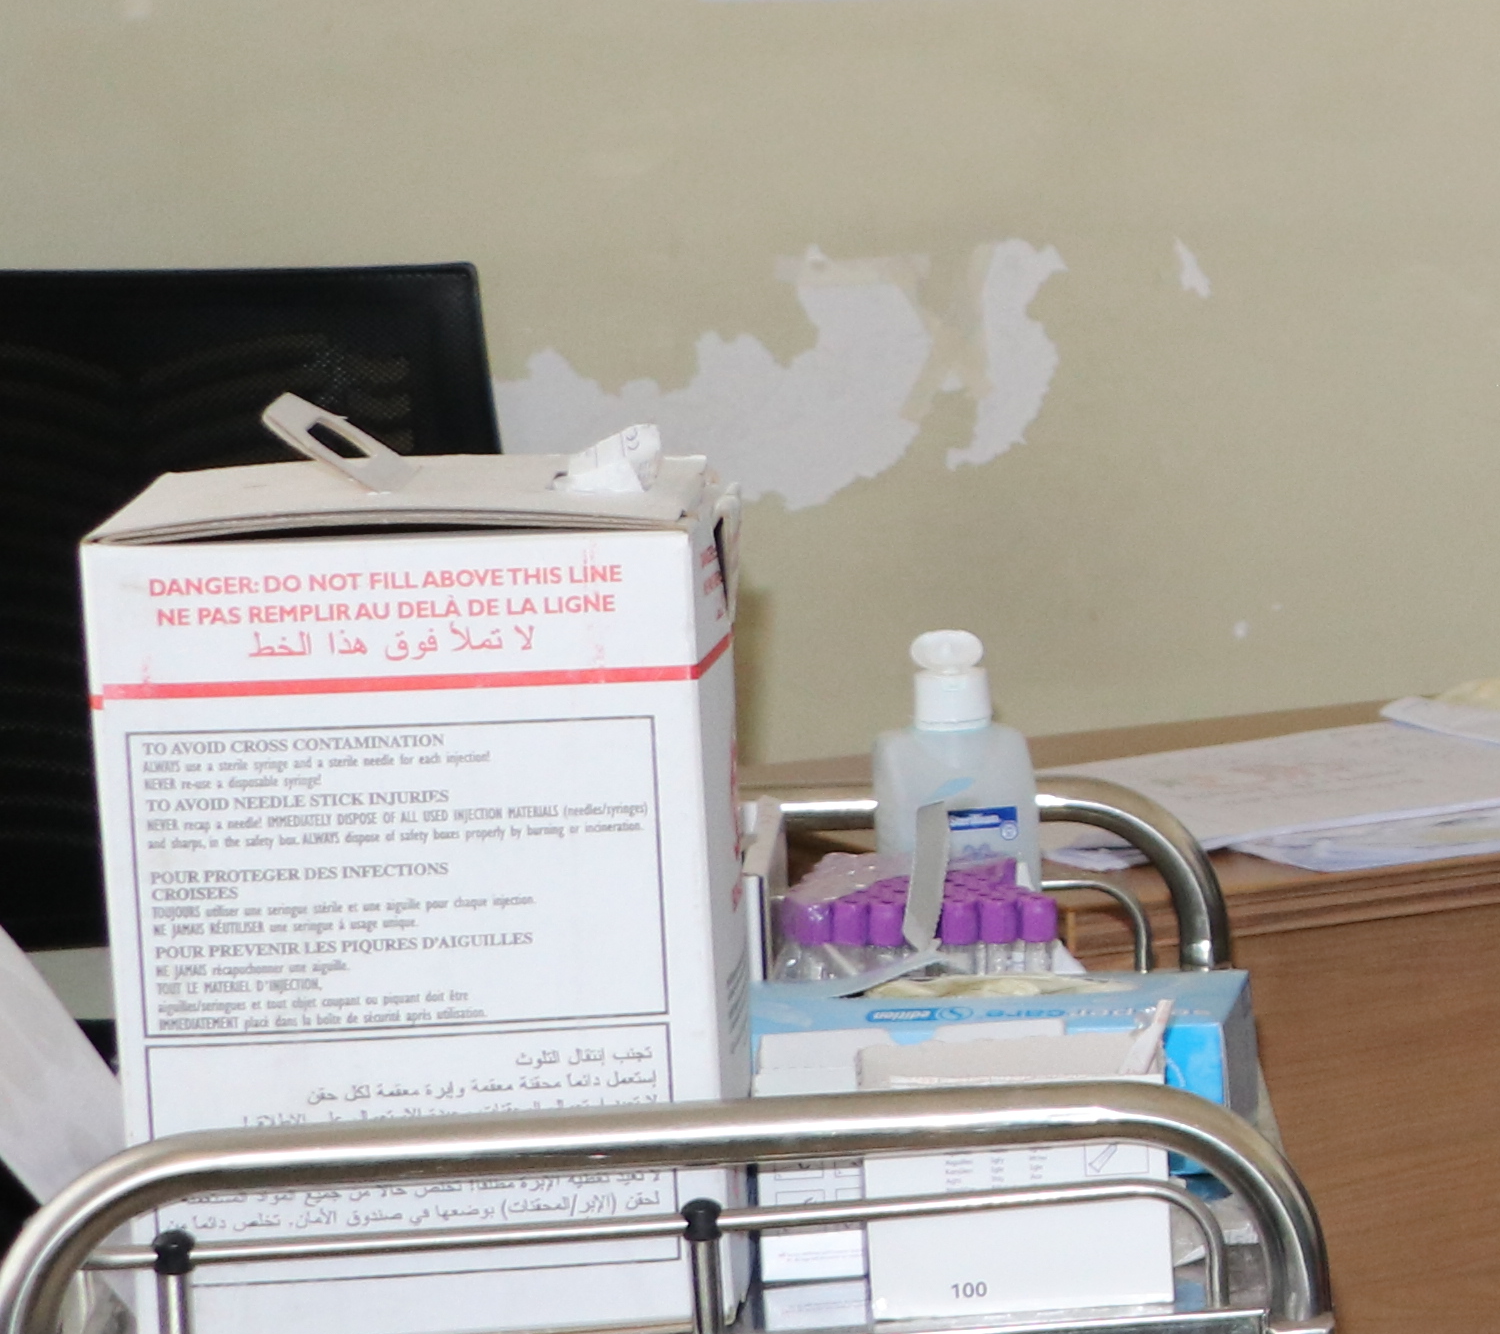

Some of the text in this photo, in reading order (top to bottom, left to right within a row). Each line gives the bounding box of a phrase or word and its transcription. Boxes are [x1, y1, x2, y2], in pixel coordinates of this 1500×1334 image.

[149, 564, 623, 597] DANGER: DO NOT FILL ABOVE THIS LINE
[157, 594, 616, 626] NE PAS REMPLIR AU DELÀ DE LA LIGNE
[248, 620, 535, 662] لا تملأ فوق هذا الخط
[142, 733, 446, 756] TO AVOID CROSS CONTAMINATION
[143, 750, 491, 774] ALWAYS use a sterile syringe and a sterile needle for each injection!
[144, 773, 322, 792] NEVER re-use a disposable syringe!
[146, 788, 450, 812] TO AVOID NEEDLE STICK INJURIES
[146, 800, 649, 833] NEVER recap a needle! IMMEDIATELY DISPOSE OF ALL USED INJECTION MATERIALS (needles/syringes)
[150, 862, 449, 885] POUR PROTEGER DES INFECTIONS
[151, 886, 239, 901] CROISEES
[155, 932, 534, 960] POUR PREVENIR LES PIQURES D'AIGUILLES
[873, 1009, 932, 1021] edition
[516, 1049, 560, 1069] التلوث
[612, 1045, 653, 1064] تجنب
[344, 1083, 371, 1103] لكل
[377, 1084, 421, 1100] معقمة
[471, 1079, 514, 1094] معقمة
[307, 1088, 338, 1107] حقن
[950, 1281, 988, 1299] 100
